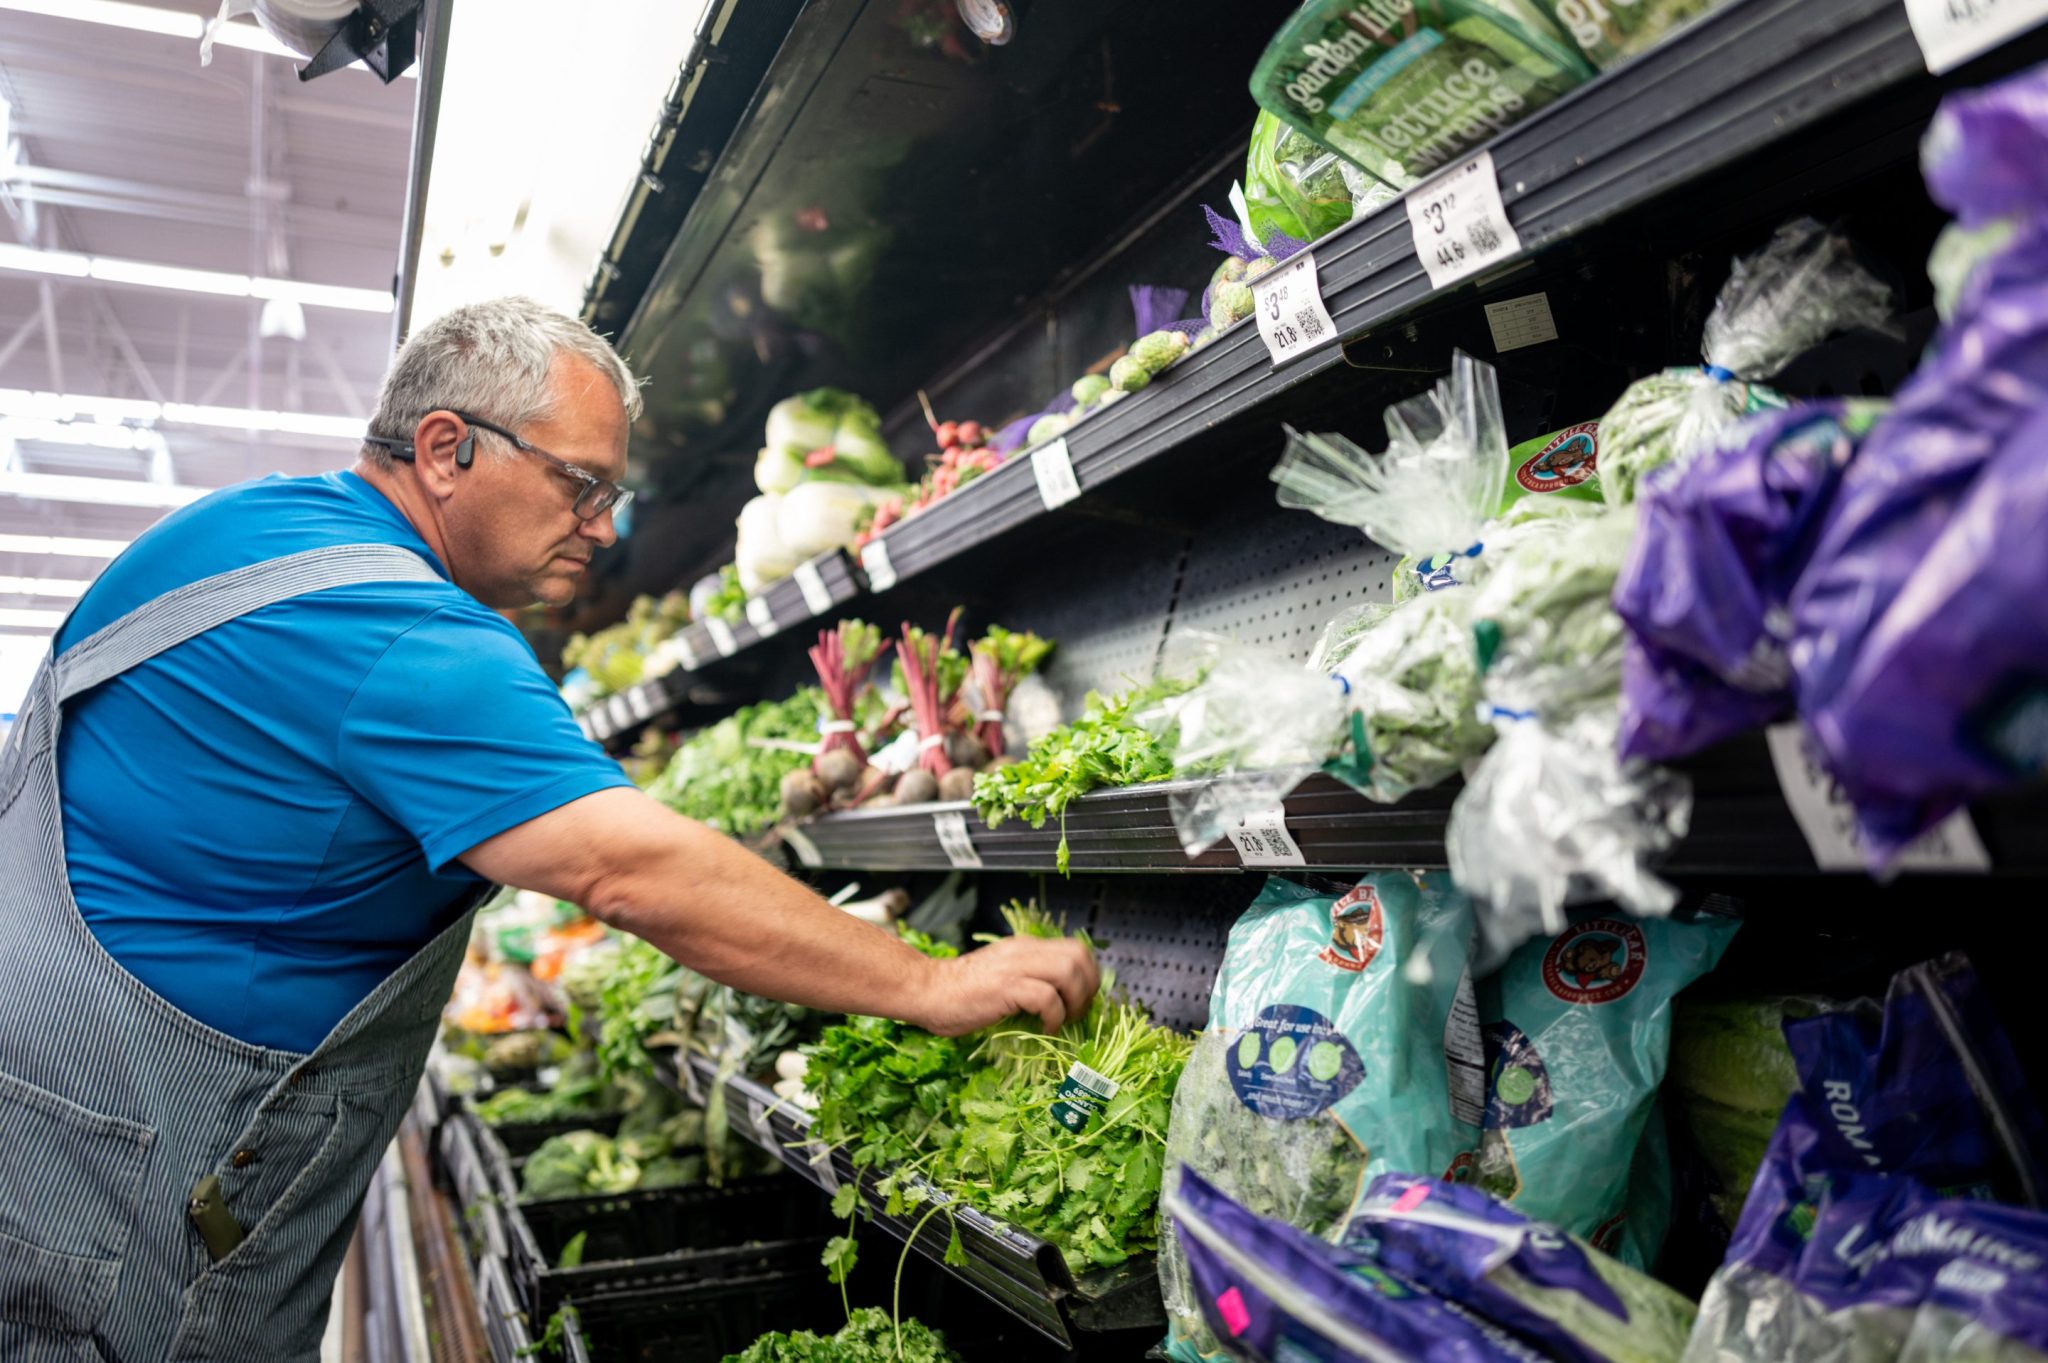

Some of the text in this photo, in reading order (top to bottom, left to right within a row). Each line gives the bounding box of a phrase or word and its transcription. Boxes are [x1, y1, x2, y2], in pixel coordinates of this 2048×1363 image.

[1286, 30, 1373, 113] garden
[1358, 57, 1498, 155] lettuce
[1406, 84, 1524, 167] wraps
[1254, 1018, 1280, 1029] Great
[1276, 1018, 1296, 1034] for
[1294, 1023, 1312, 1033] use
